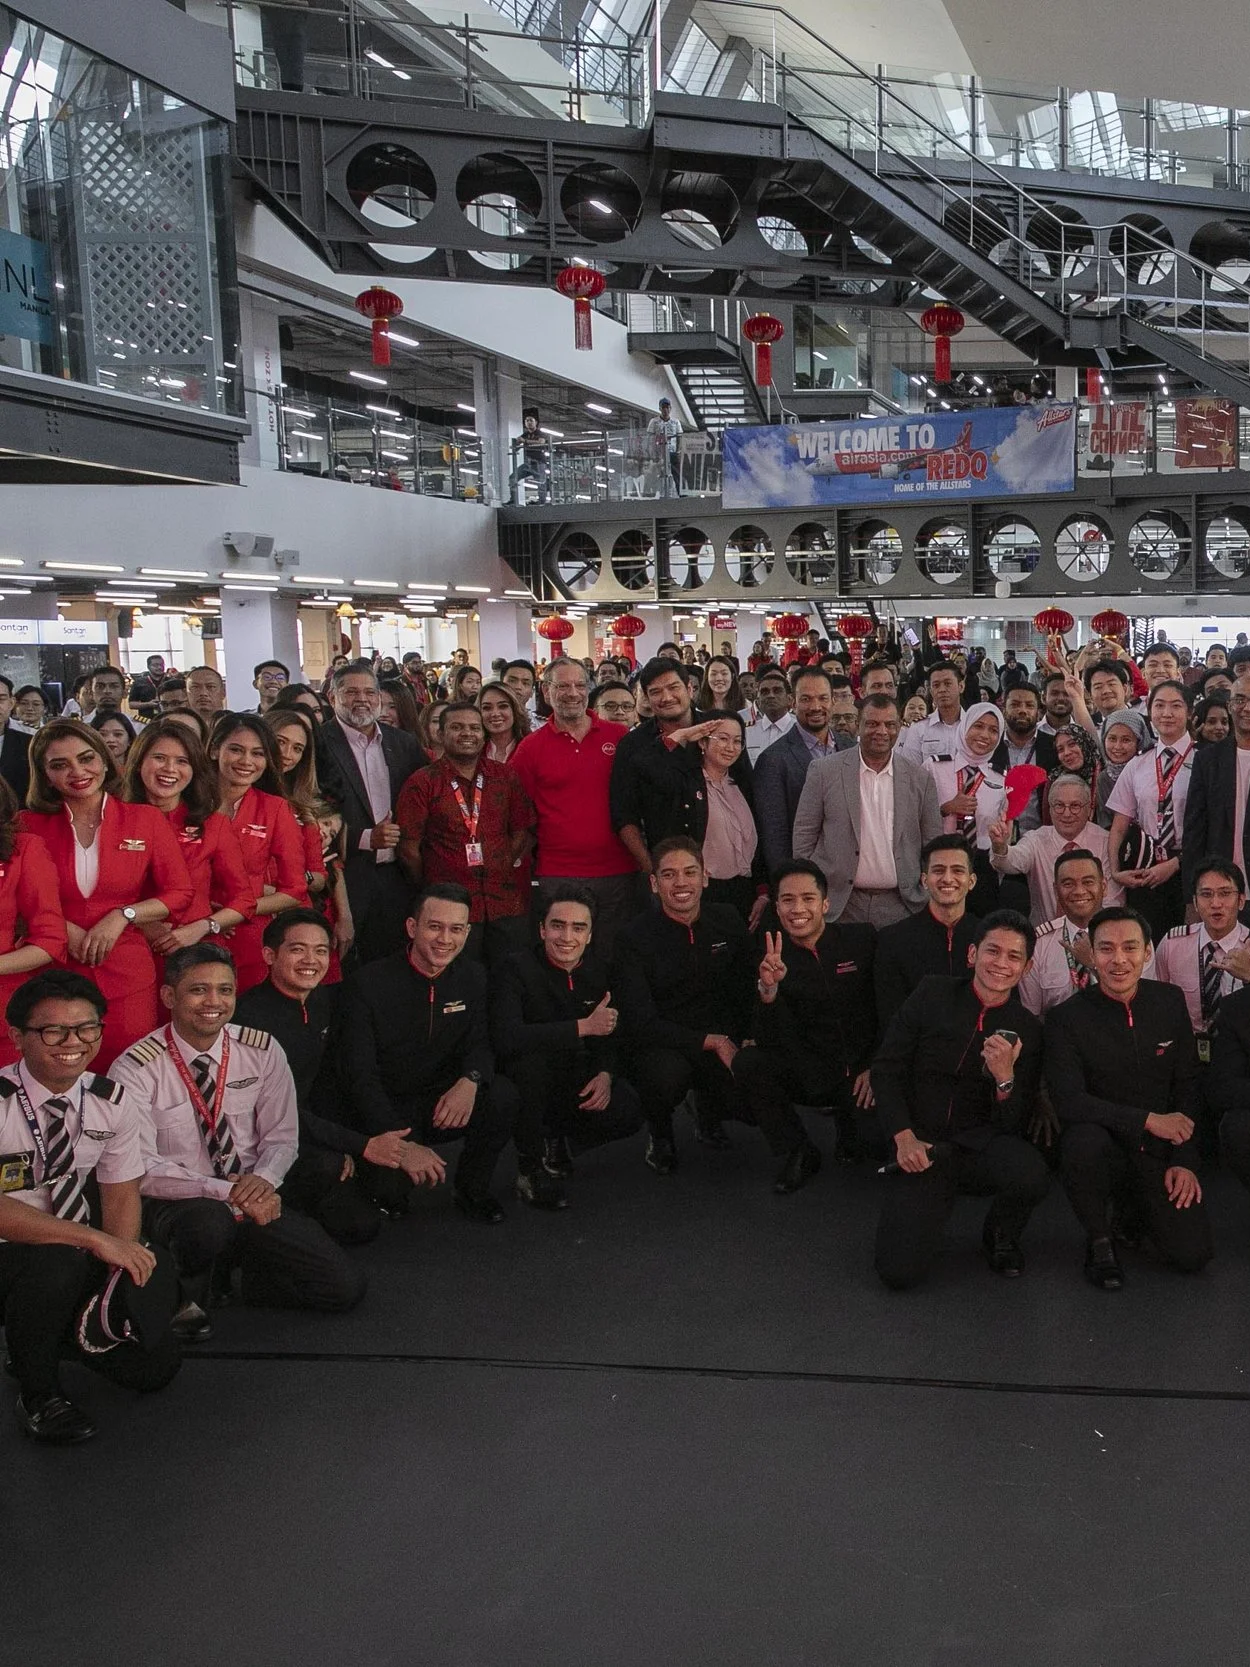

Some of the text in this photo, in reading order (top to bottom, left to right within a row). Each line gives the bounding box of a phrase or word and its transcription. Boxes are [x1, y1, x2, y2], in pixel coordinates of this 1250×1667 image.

[0, 257, 50, 304] NL
[1037, 408, 1072, 432] Allstars
[796, 423, 936, 459] WELCOME TO
[841, 450, 918, 466] airasia.com
[926, 450, 988, 481] REDQ
[894, 480, 972, 493] HOME OF THE ALLSTARS
[19, 1094, 35, 1121] AIRBUS
